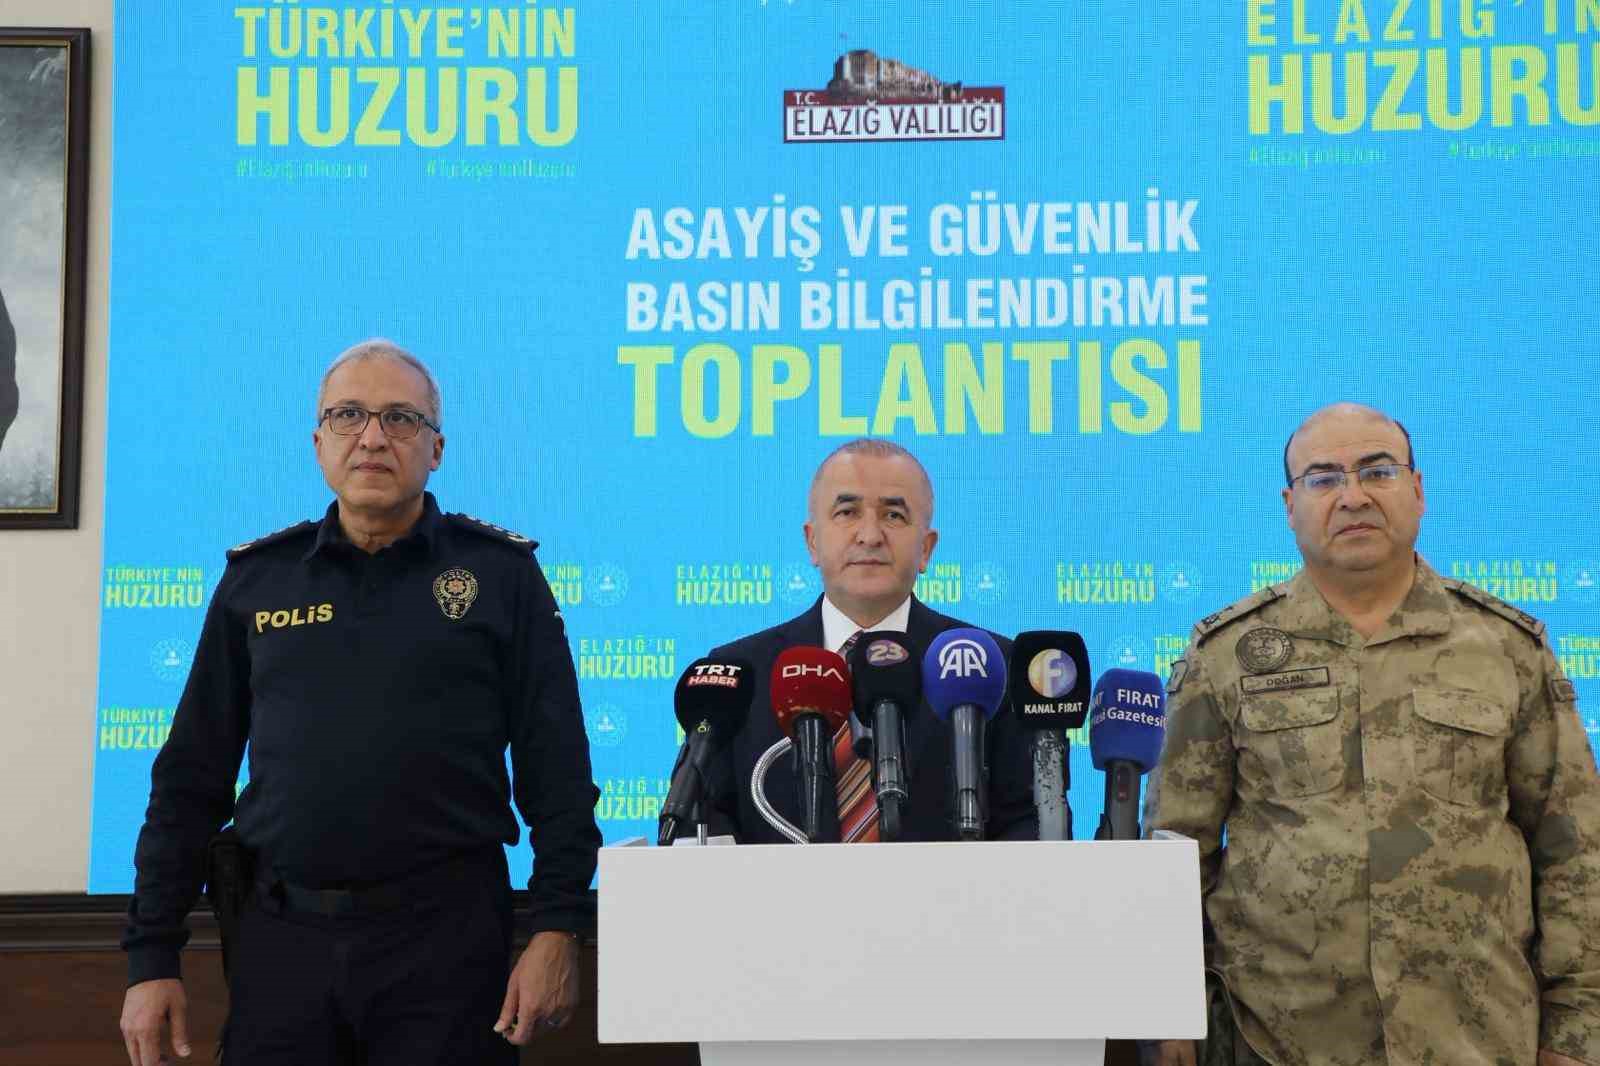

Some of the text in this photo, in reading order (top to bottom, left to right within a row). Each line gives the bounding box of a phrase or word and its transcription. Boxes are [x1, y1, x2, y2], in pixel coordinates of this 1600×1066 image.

[794, 92, 820, 105] T.C.
[1248, 42, 1600, 135] HUZURU
[236, 66, 579, 147] HUZURU
[793, 98, 996, 136] ELAZIĞ VALİLİĞİ
[625, 188, 1200, 272] ASAYİŞ VE GÜVENLİK
[626, 264, 1209, 332] BASIN BİLGİLENDİRME
[617, 338, 1202, 438] TOPLANTISI
[105, 583, 203, 608] HUZURU
[676, 581, 773, 605] HUZURU
[1057, 578, 1155, 603] HUZURU
[579, 655, 675, 679] HUZURU
[694, 664, 742, 677] TRT
[940, 648, 988, 679] AA
[687, 675, 738, 688] HABER
[1024, 702, 1083, 714] KANAL FIRAT
[1117, 688, 1161, 709] FIRAT
[1107, 706, 1164, 728] Gazetesi
[101, 726, 173, 750] HUZU
